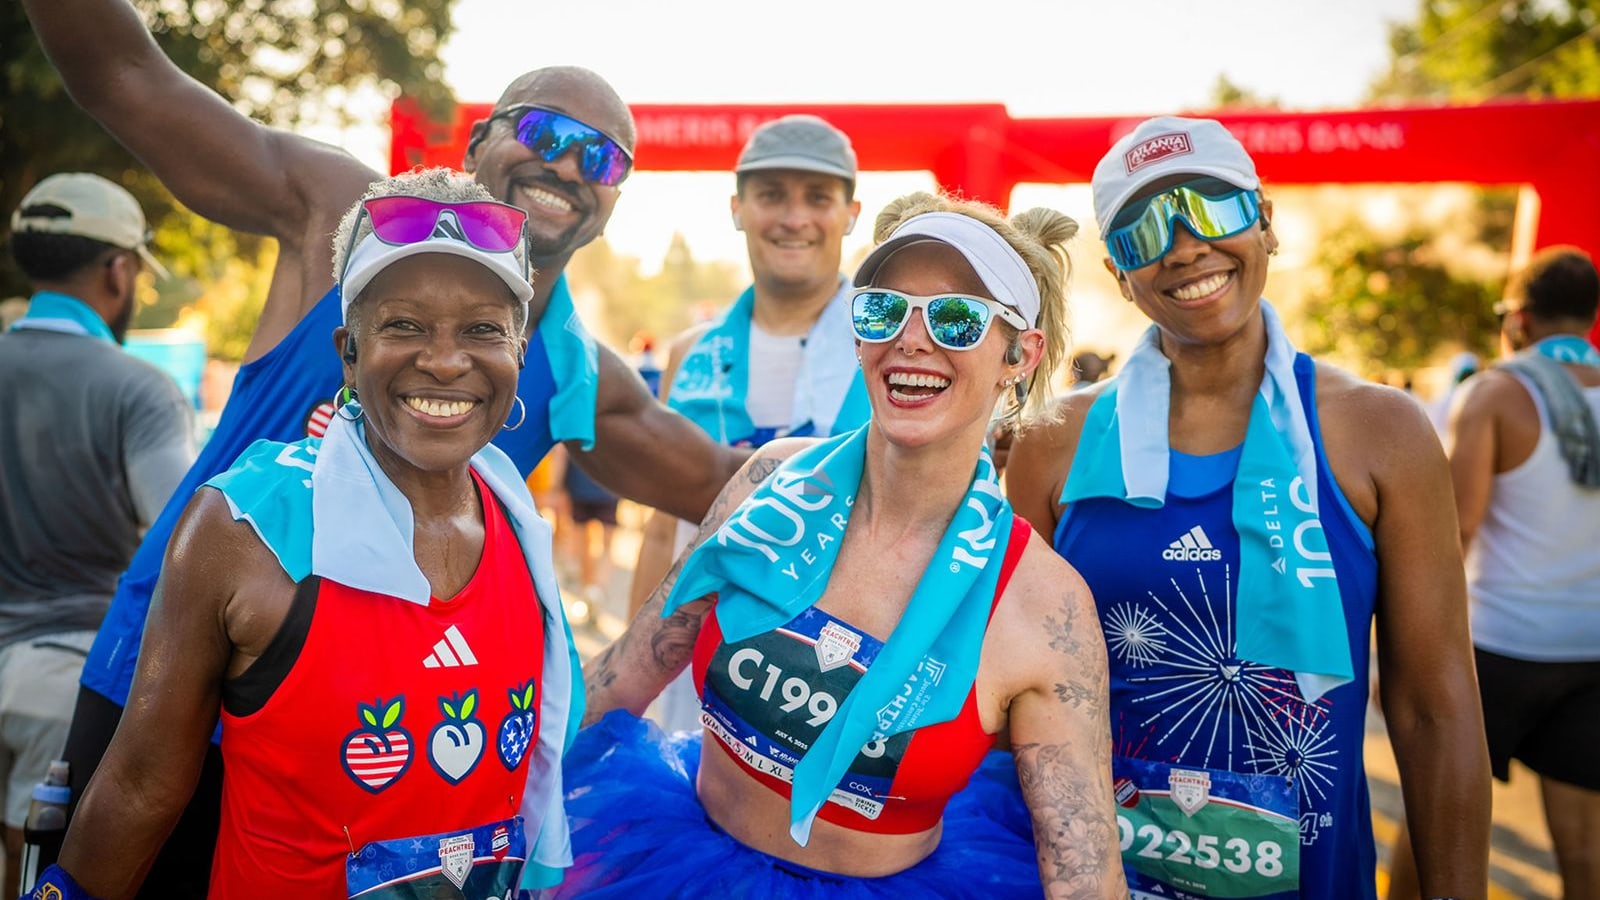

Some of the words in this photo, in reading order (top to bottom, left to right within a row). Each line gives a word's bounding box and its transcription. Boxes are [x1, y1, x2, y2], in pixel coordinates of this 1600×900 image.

[1131, 136, 1183, 159] ATLANTA
[1259, 477, 1284, 548] DELTA
[1288, 476, 1337, 588] 100
[1162, 548, 1222, 562] adidas
[822, 628, 859, 650] PEACHTREE
[744, 751, 753, 764] M
[757, 759, 763, 769] L
[770, 764, 783, 777] XL
[849, 781, 872, 796] COX
[1170, 776, 1209, 787] PEACHTREE
[855, 797, 876, 808] DRINK
[855, 802, 877, 815] TICKET
[439, 842, 474, 856] PEACHTREE
